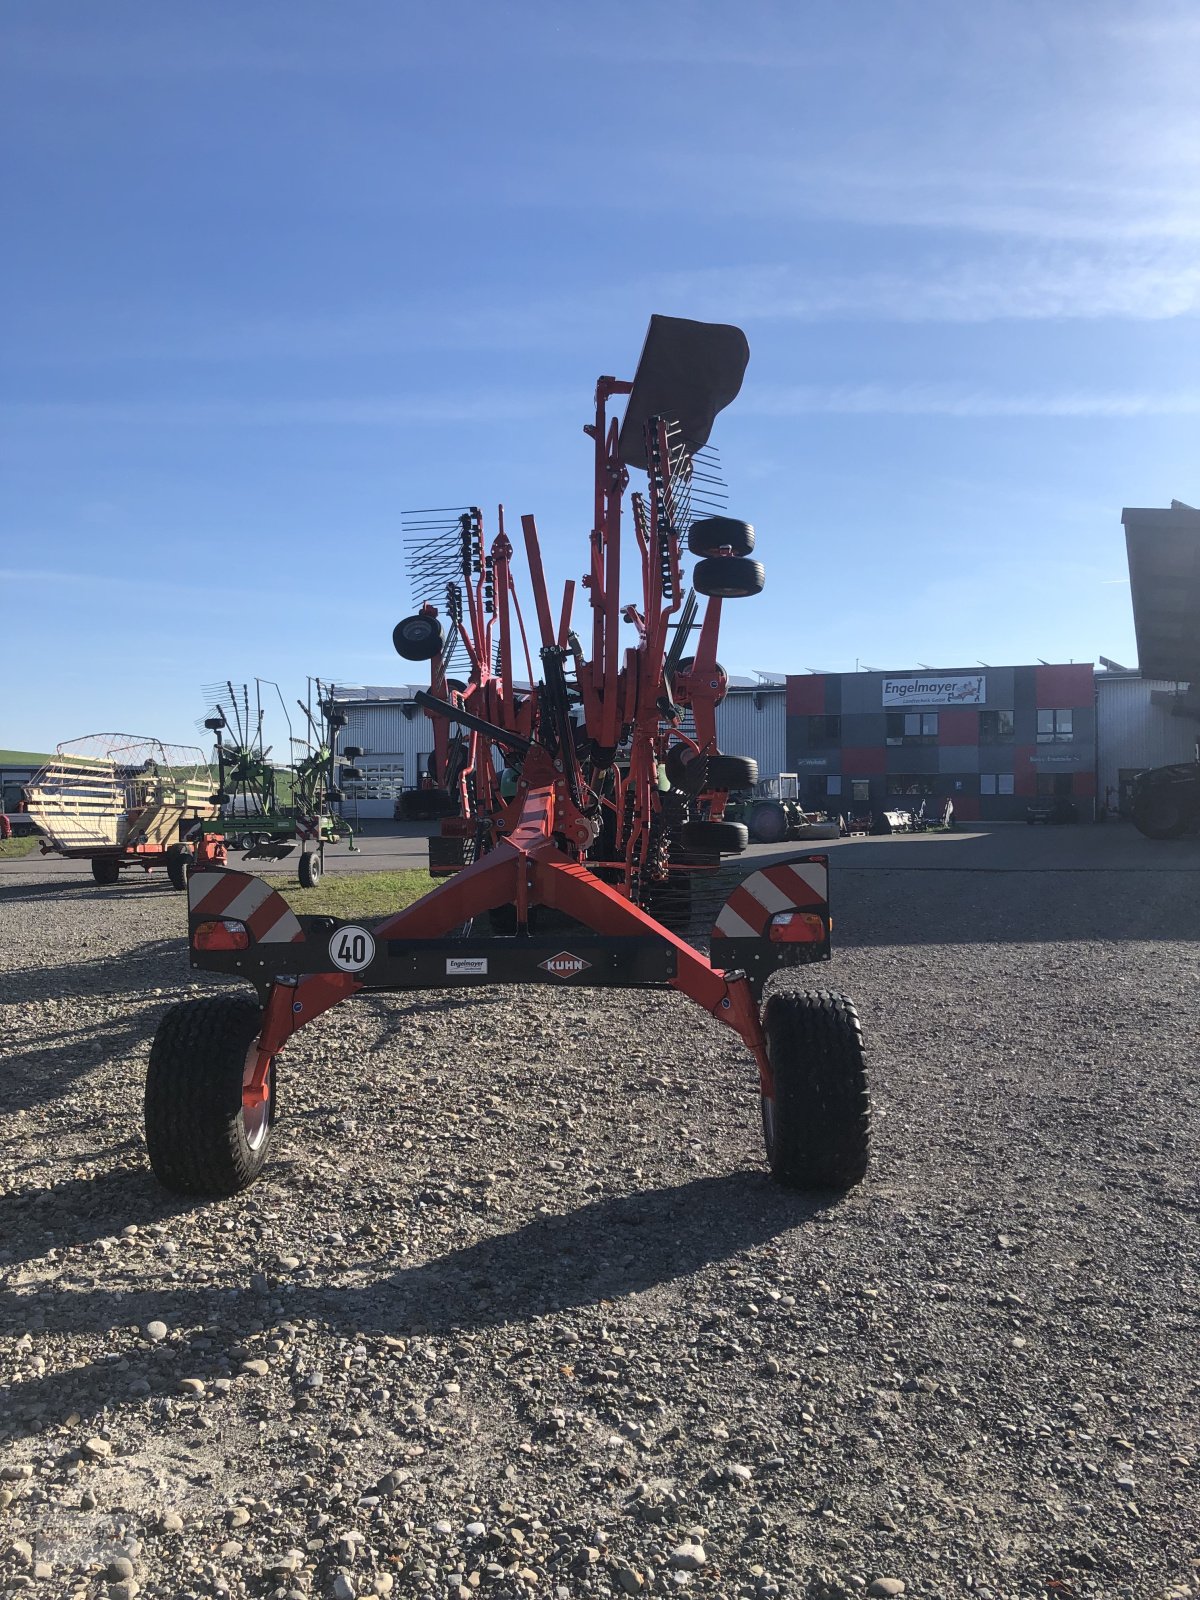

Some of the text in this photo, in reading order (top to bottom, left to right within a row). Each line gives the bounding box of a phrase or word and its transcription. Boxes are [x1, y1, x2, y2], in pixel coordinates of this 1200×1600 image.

[885, 680, 957, 696] Engelmayer
[338, 935, 365, 963] 40
[450, 960, 484, 968] Engelmayer
[547, 960, 583, 970] KUHN
